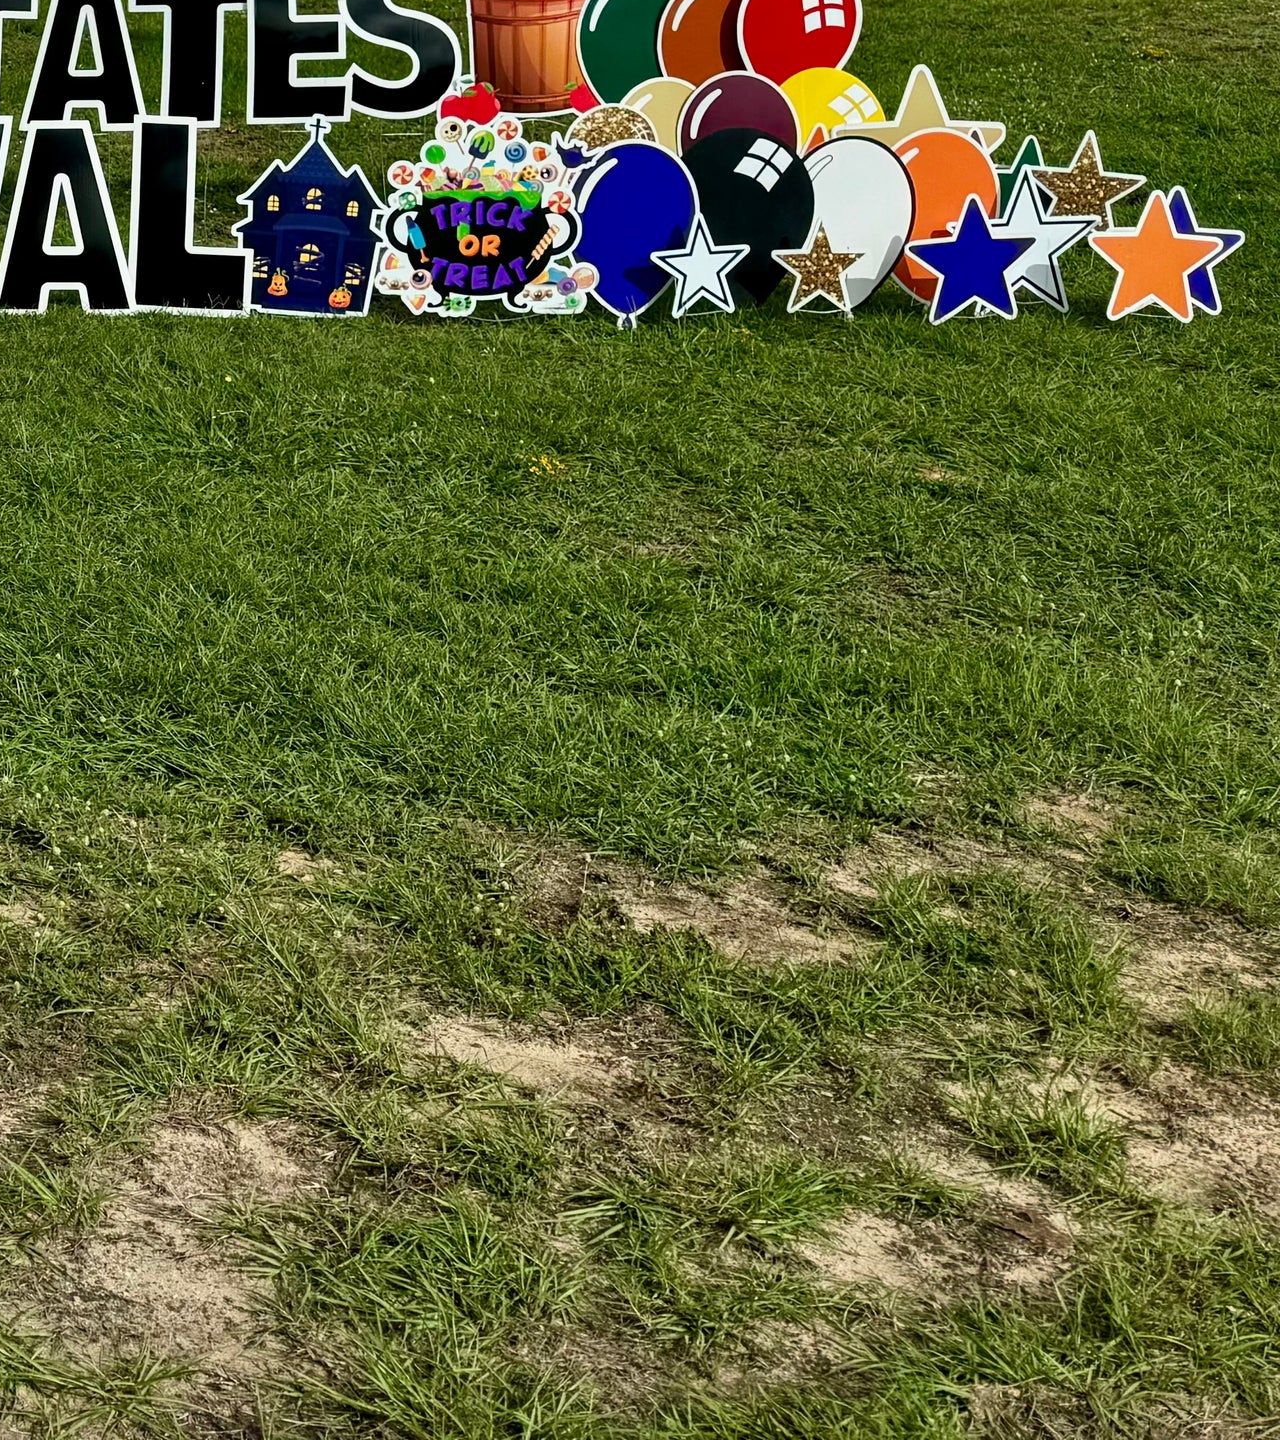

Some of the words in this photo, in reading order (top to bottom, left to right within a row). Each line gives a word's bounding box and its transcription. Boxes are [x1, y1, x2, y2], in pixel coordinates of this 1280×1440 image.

[429, 200, 534, 233] TRICK
[459, 234, 501, 257] OR
[431, 256, 528, 291] TREAT
